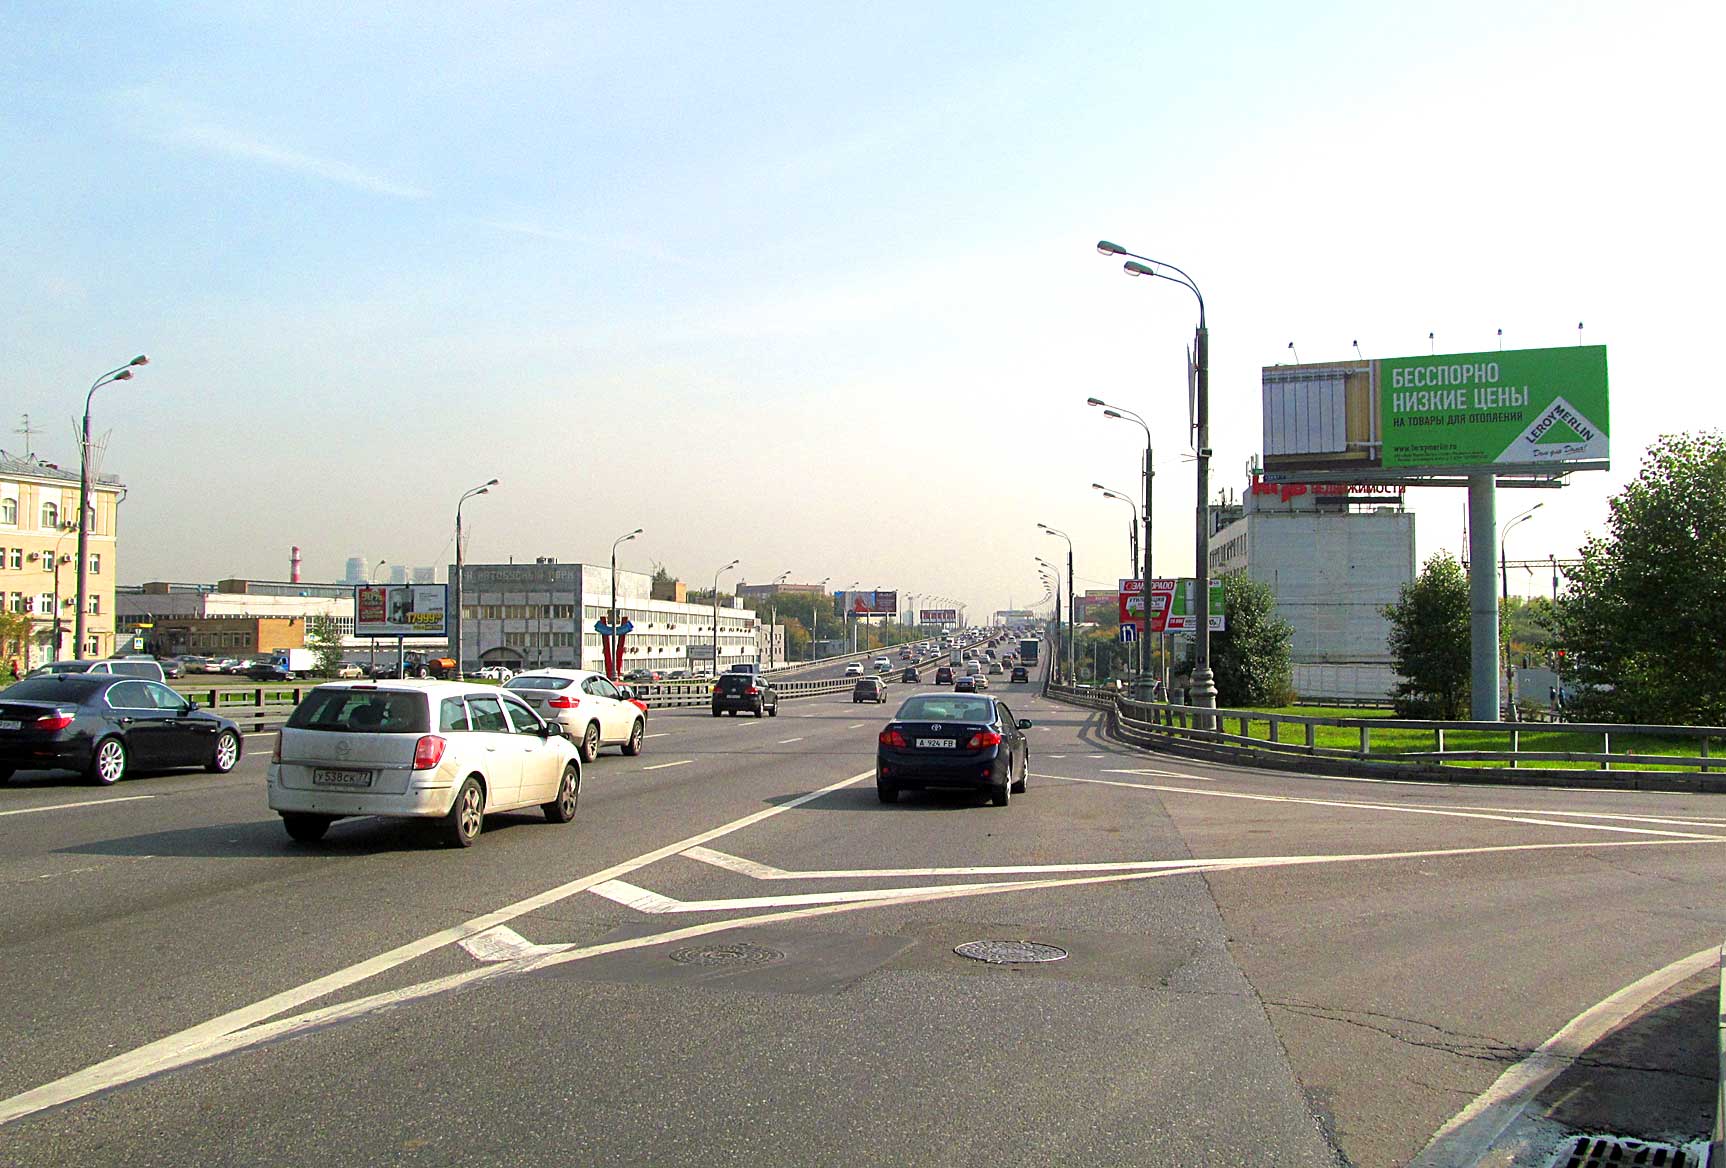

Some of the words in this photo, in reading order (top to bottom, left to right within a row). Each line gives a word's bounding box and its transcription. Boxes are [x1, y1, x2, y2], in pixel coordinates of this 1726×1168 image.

[1392, 362, 1499, 388] БЕССПОРНО
[1392, 389, 1467, 413] НИЗКИЕ
[1474, 385, 1529, 410] ЦЕНЫ
[1393, 417, 1405, 427] НА
[1408, 415, 1444, 426] ТОВАРЫ
[1447, 414, 1466, 425] ДЛЯ
[1469, 411, 1523, 424] ОТОПЛЕНИЯ
[1525, 411, 1558, 443] LEROY
[1553, 404, 1595, 441] MERLIN
